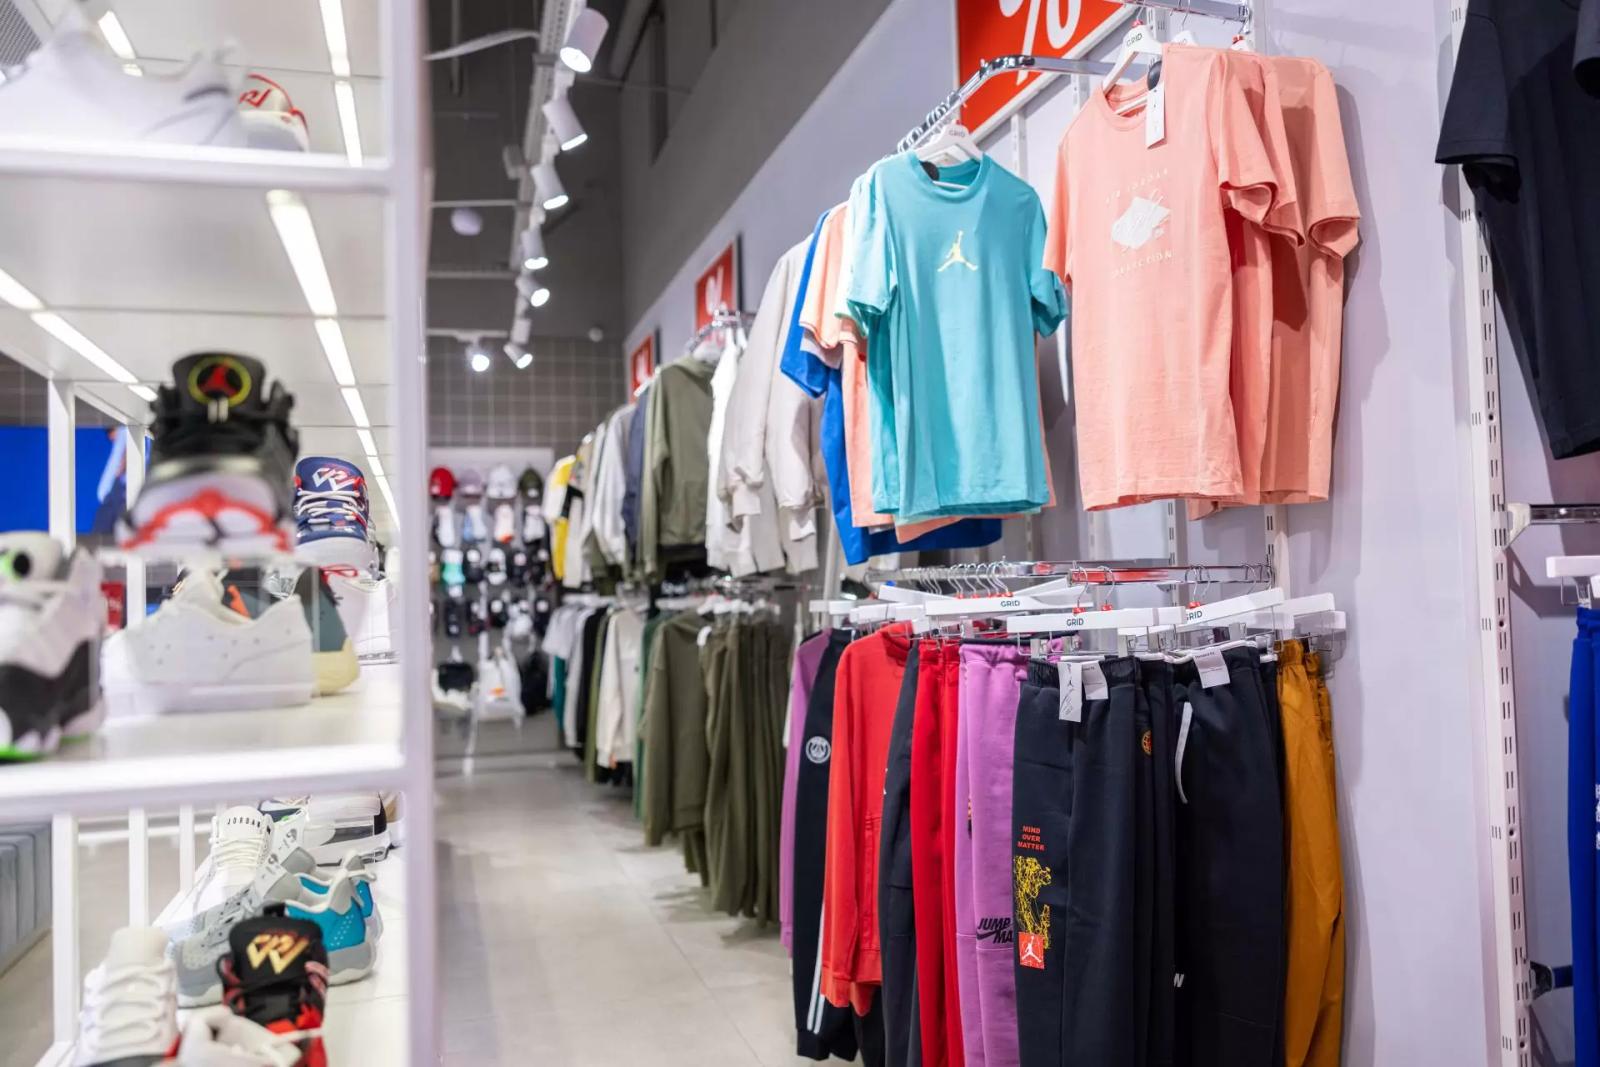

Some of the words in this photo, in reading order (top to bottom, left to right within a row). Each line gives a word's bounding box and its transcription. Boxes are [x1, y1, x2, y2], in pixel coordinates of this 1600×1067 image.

[1000, 600, 1020, 608] GRID
[1066, 617, 1084, 627] GRID
[1022, 825, 1041, 833] MIND
[1022, 834, 1041, 842] OVER
[1017, 841, 1045, 851] MATTER
